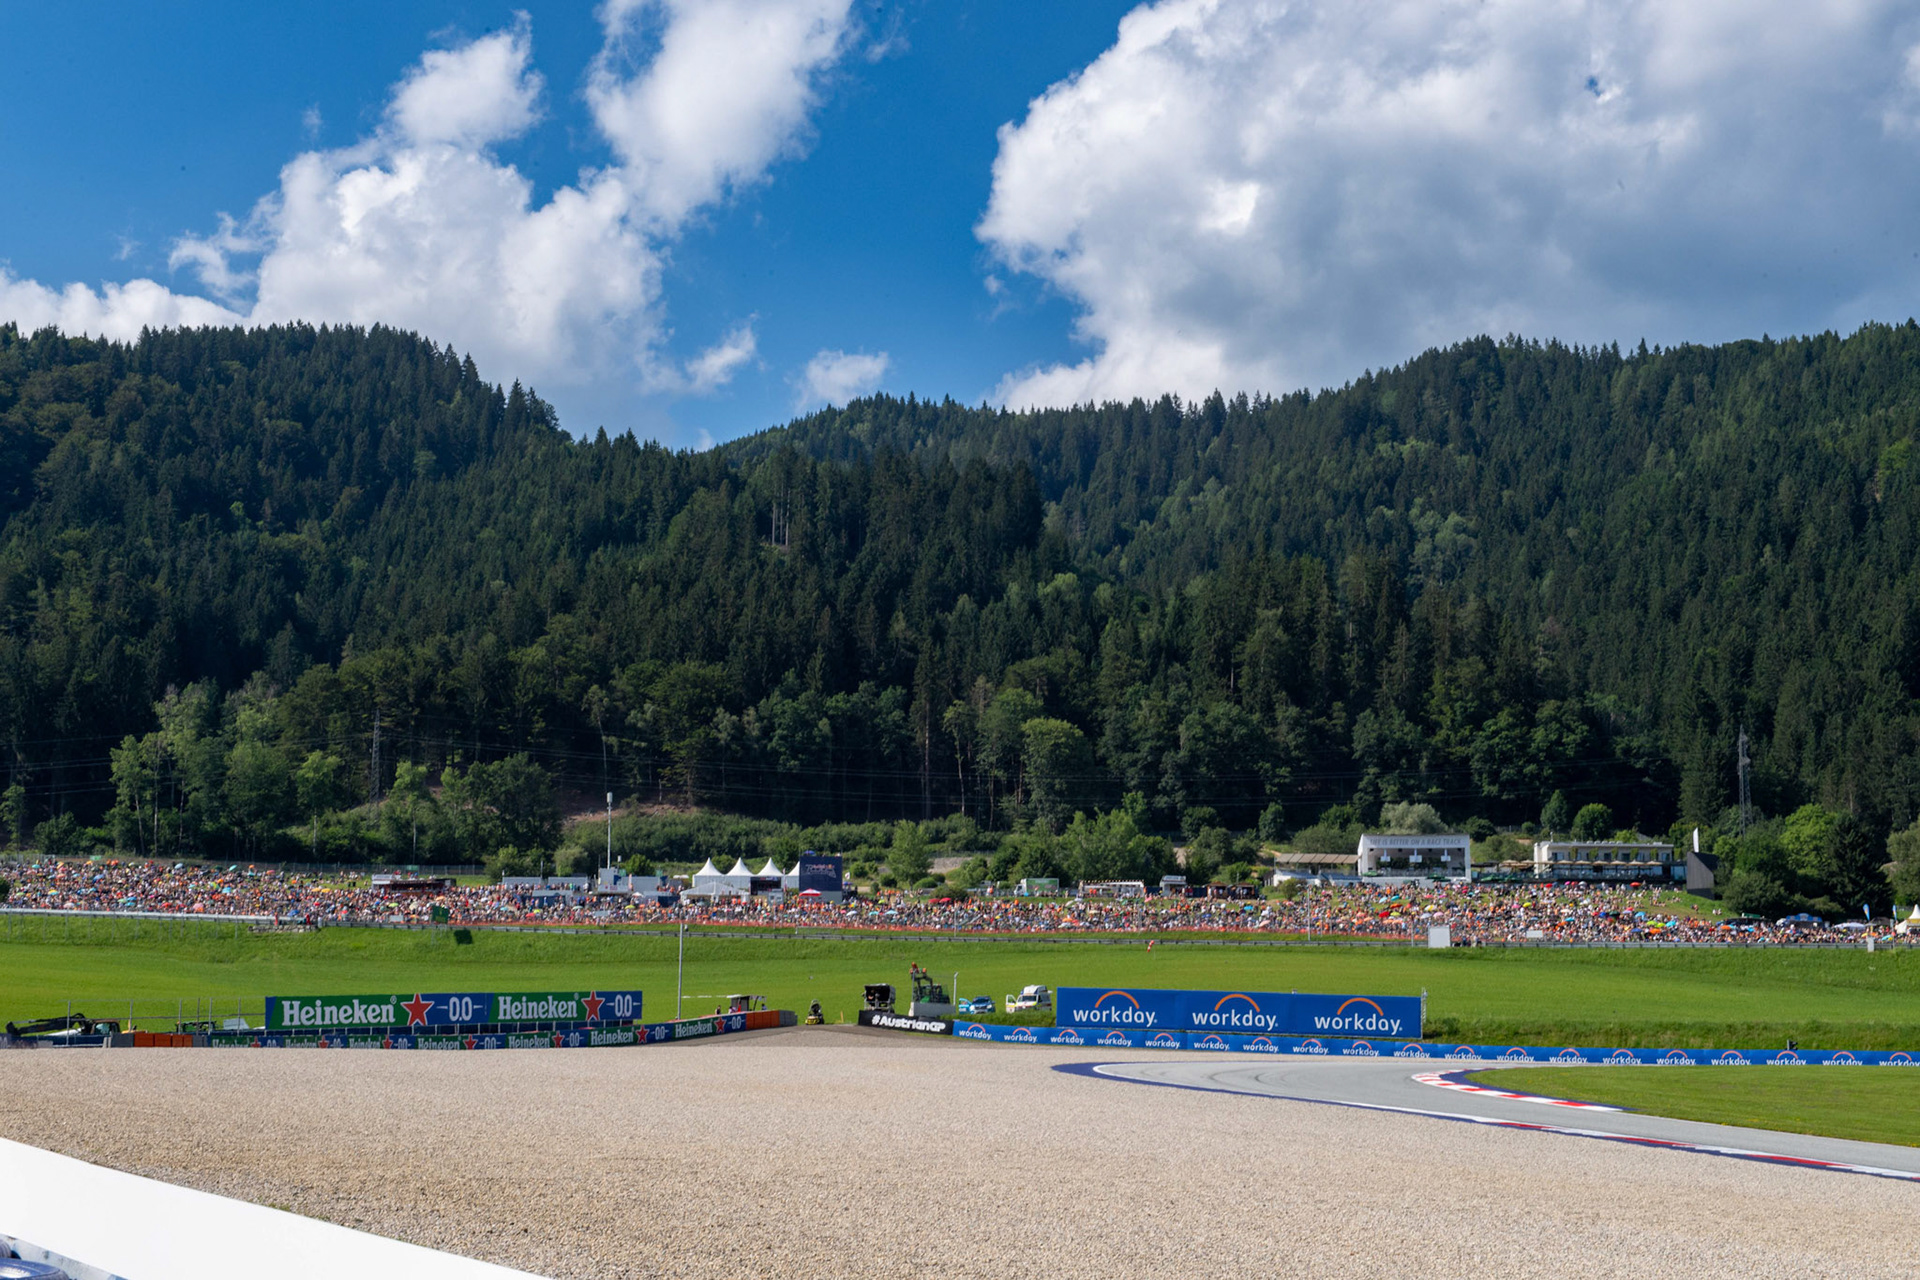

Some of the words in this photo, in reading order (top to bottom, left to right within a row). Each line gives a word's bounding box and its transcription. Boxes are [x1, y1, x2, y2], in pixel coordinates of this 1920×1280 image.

[1443, 838, 1462, 846] TRACK
[281, 999, 396, 1026] Heineken
[497, 995, 578, 1020] Heineken
[1073, 1006, 1156, 1028] workday
[1192, 1009, 1277, 1031] workday
[1314, 1013, 1401, 1036] workday
[590, 1029, 634, 1046] Heineken
[959, 1029, 991, 1041] workday
[1004, 1032, 1037, 1043] workday
[1051, 1035, 1084, 1045] workday
[1097, 1037, 1131, 1047] workday
[1145, 1039, 1180, 1049] workday
[1194, 1041, 1229, 1051] workday
[1243, 1042, 1278, 1053] workday
[1293, 1045, 1328, 1055] workday
[1343, 1047, 1379, 1057] workday
